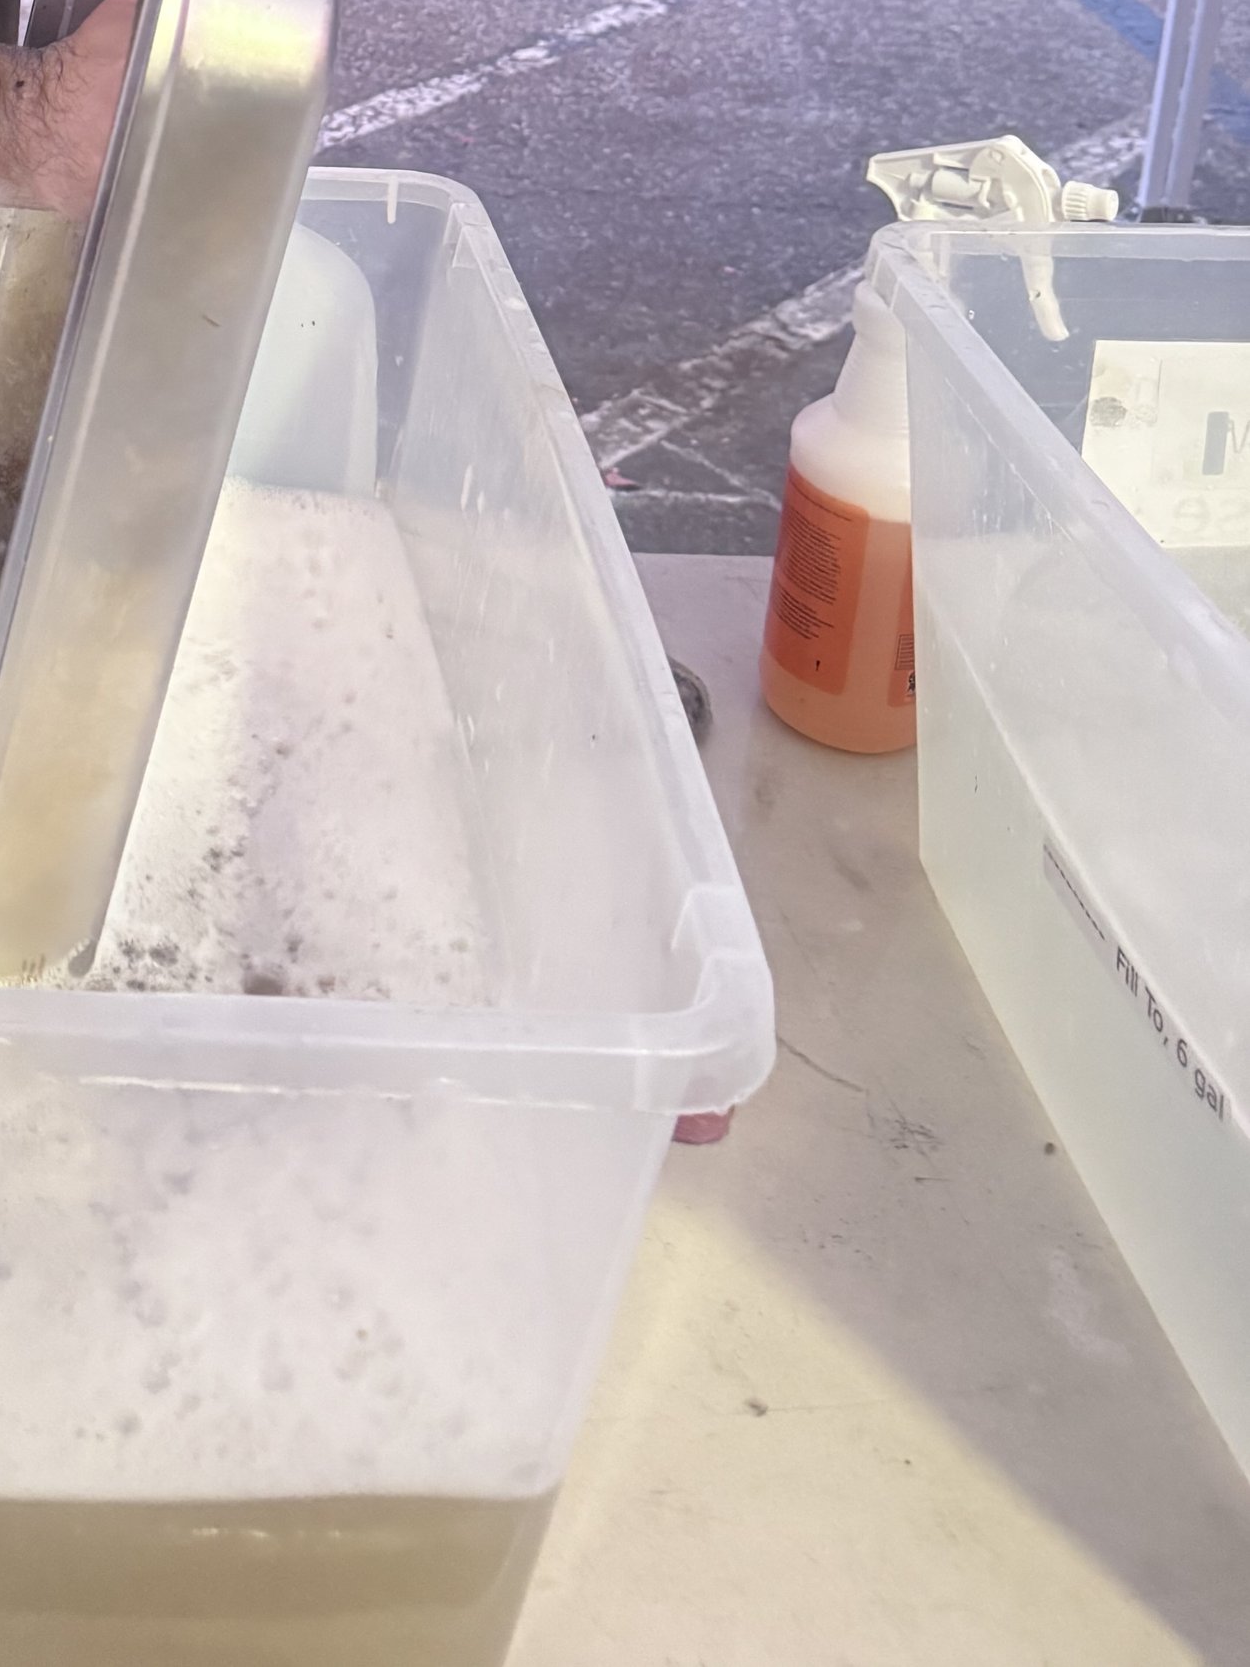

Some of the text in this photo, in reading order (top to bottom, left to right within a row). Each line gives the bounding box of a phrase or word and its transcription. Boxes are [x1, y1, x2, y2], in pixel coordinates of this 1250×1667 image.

[1116, 946, 1138, 997] Fill
[1177, 1038, 1189, 1069] 6
[1195, 1068, 1224, 1121] gal
